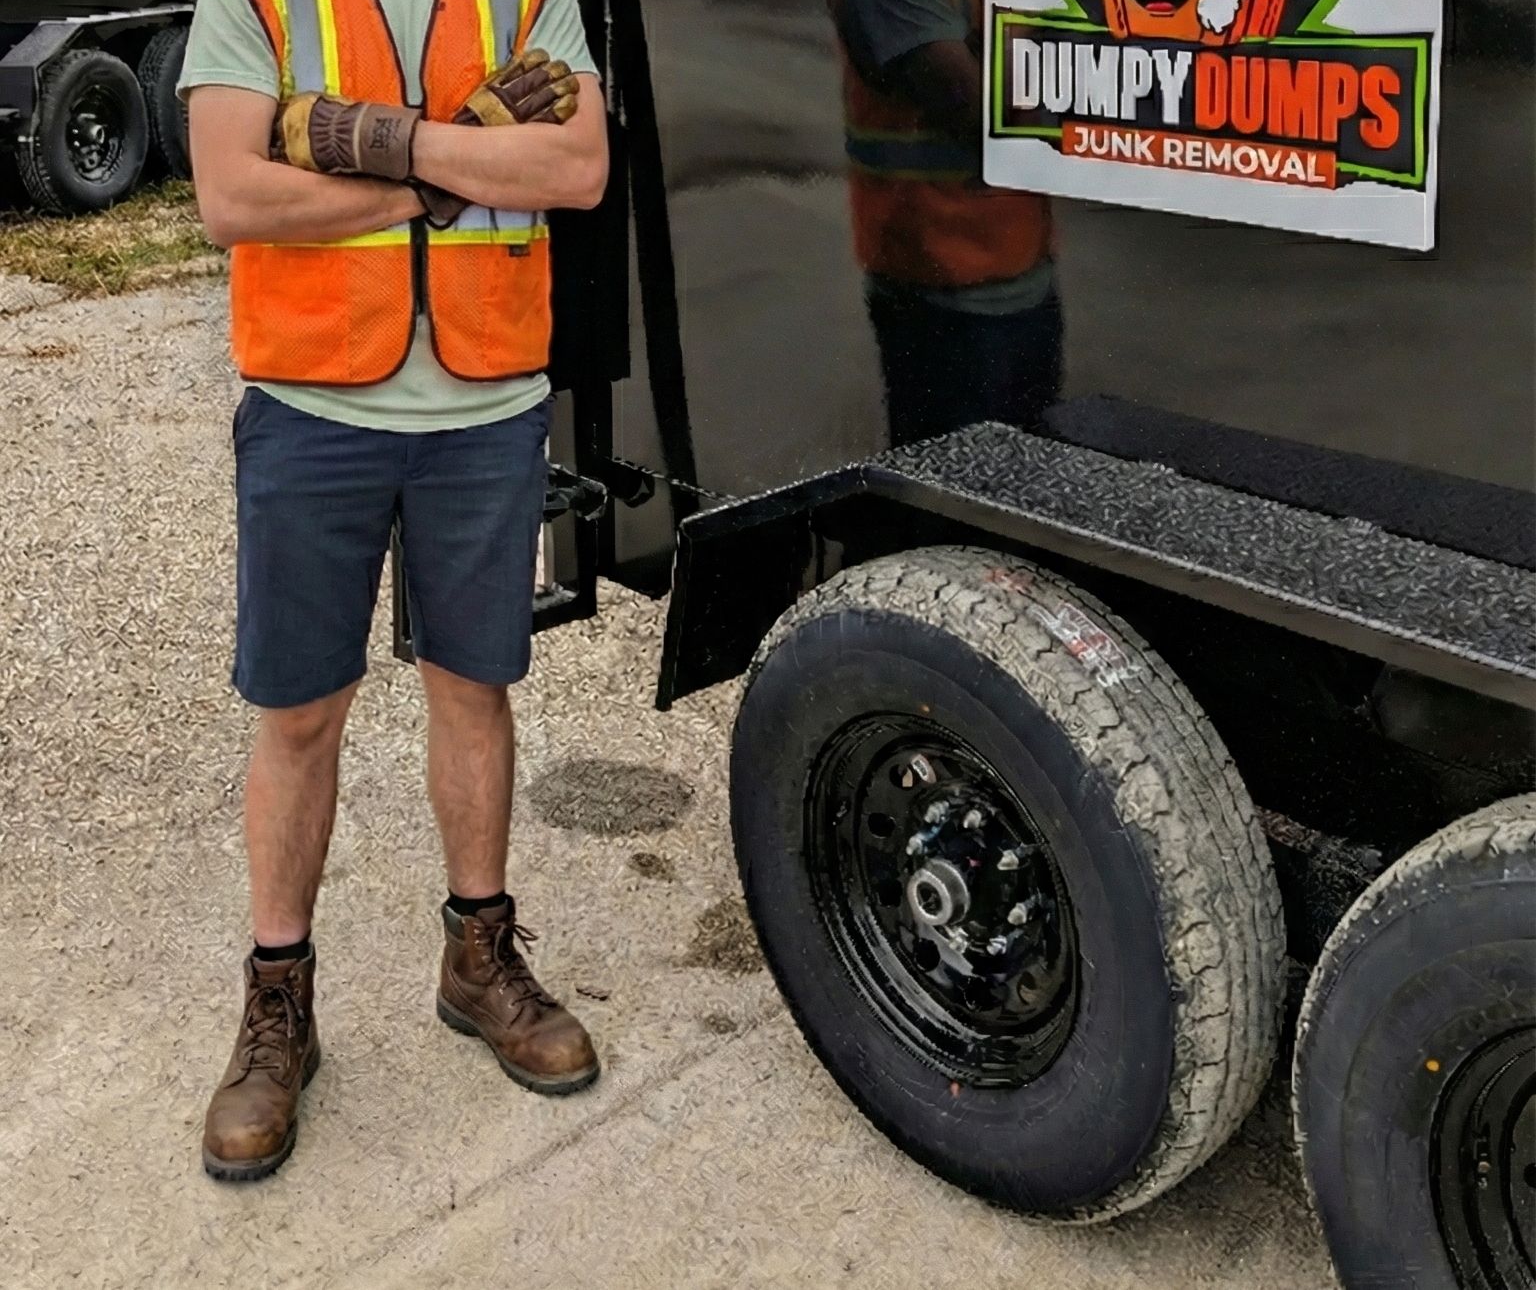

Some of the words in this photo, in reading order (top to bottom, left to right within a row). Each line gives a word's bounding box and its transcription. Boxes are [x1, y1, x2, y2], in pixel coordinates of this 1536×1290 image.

[1012, 38, 1192, 125] DUMPY
[1195, 51, 1401, 150] DUMPS
[1073, 126, 1154, 163] JUNK
[1162, 140, 1327, 183] REMOVAL
